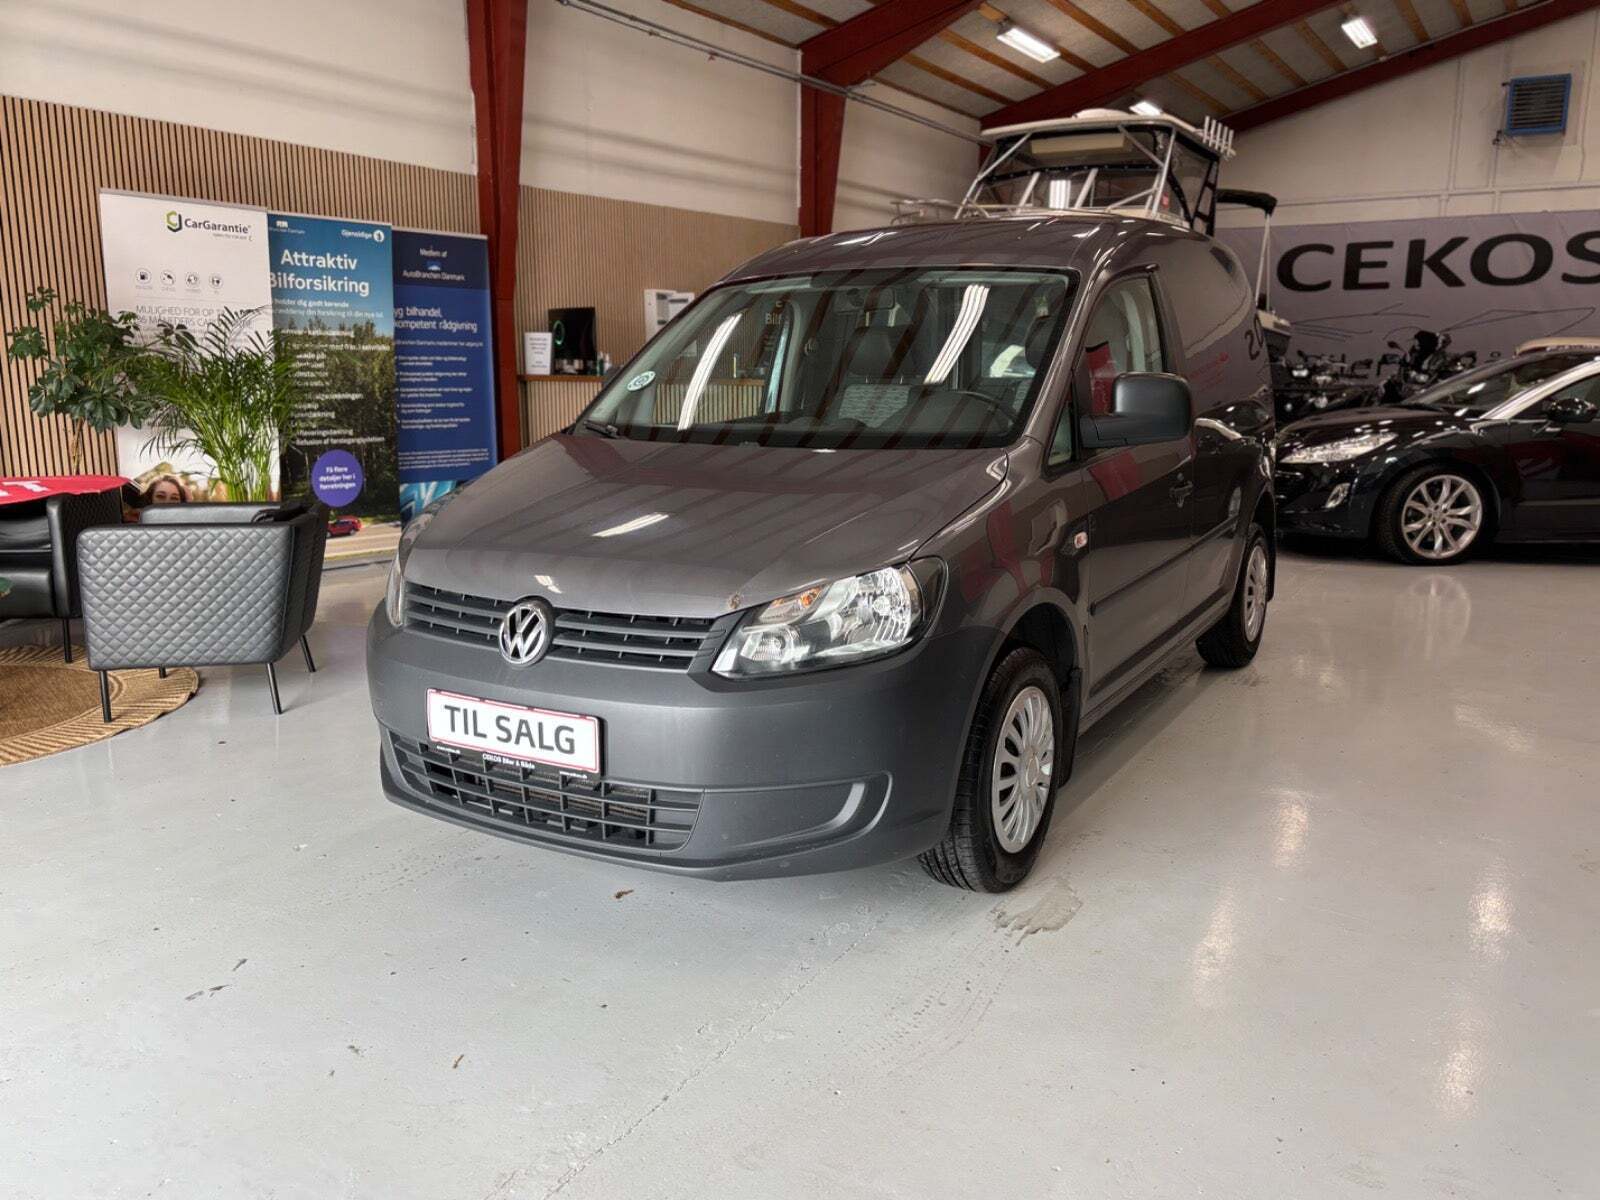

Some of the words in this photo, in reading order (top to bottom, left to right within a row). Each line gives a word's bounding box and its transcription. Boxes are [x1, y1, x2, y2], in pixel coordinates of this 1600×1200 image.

[184, 217, 248, 233] CarGarantie
[281, 248, 358, 270] Attraktiv
[1276, 229, 1600, 292] CEKOS
[270, 270, 370, 297] Bilforsikring
[443, 703, 487, 739] TIL
[494, 714, 575, 755] SALG
